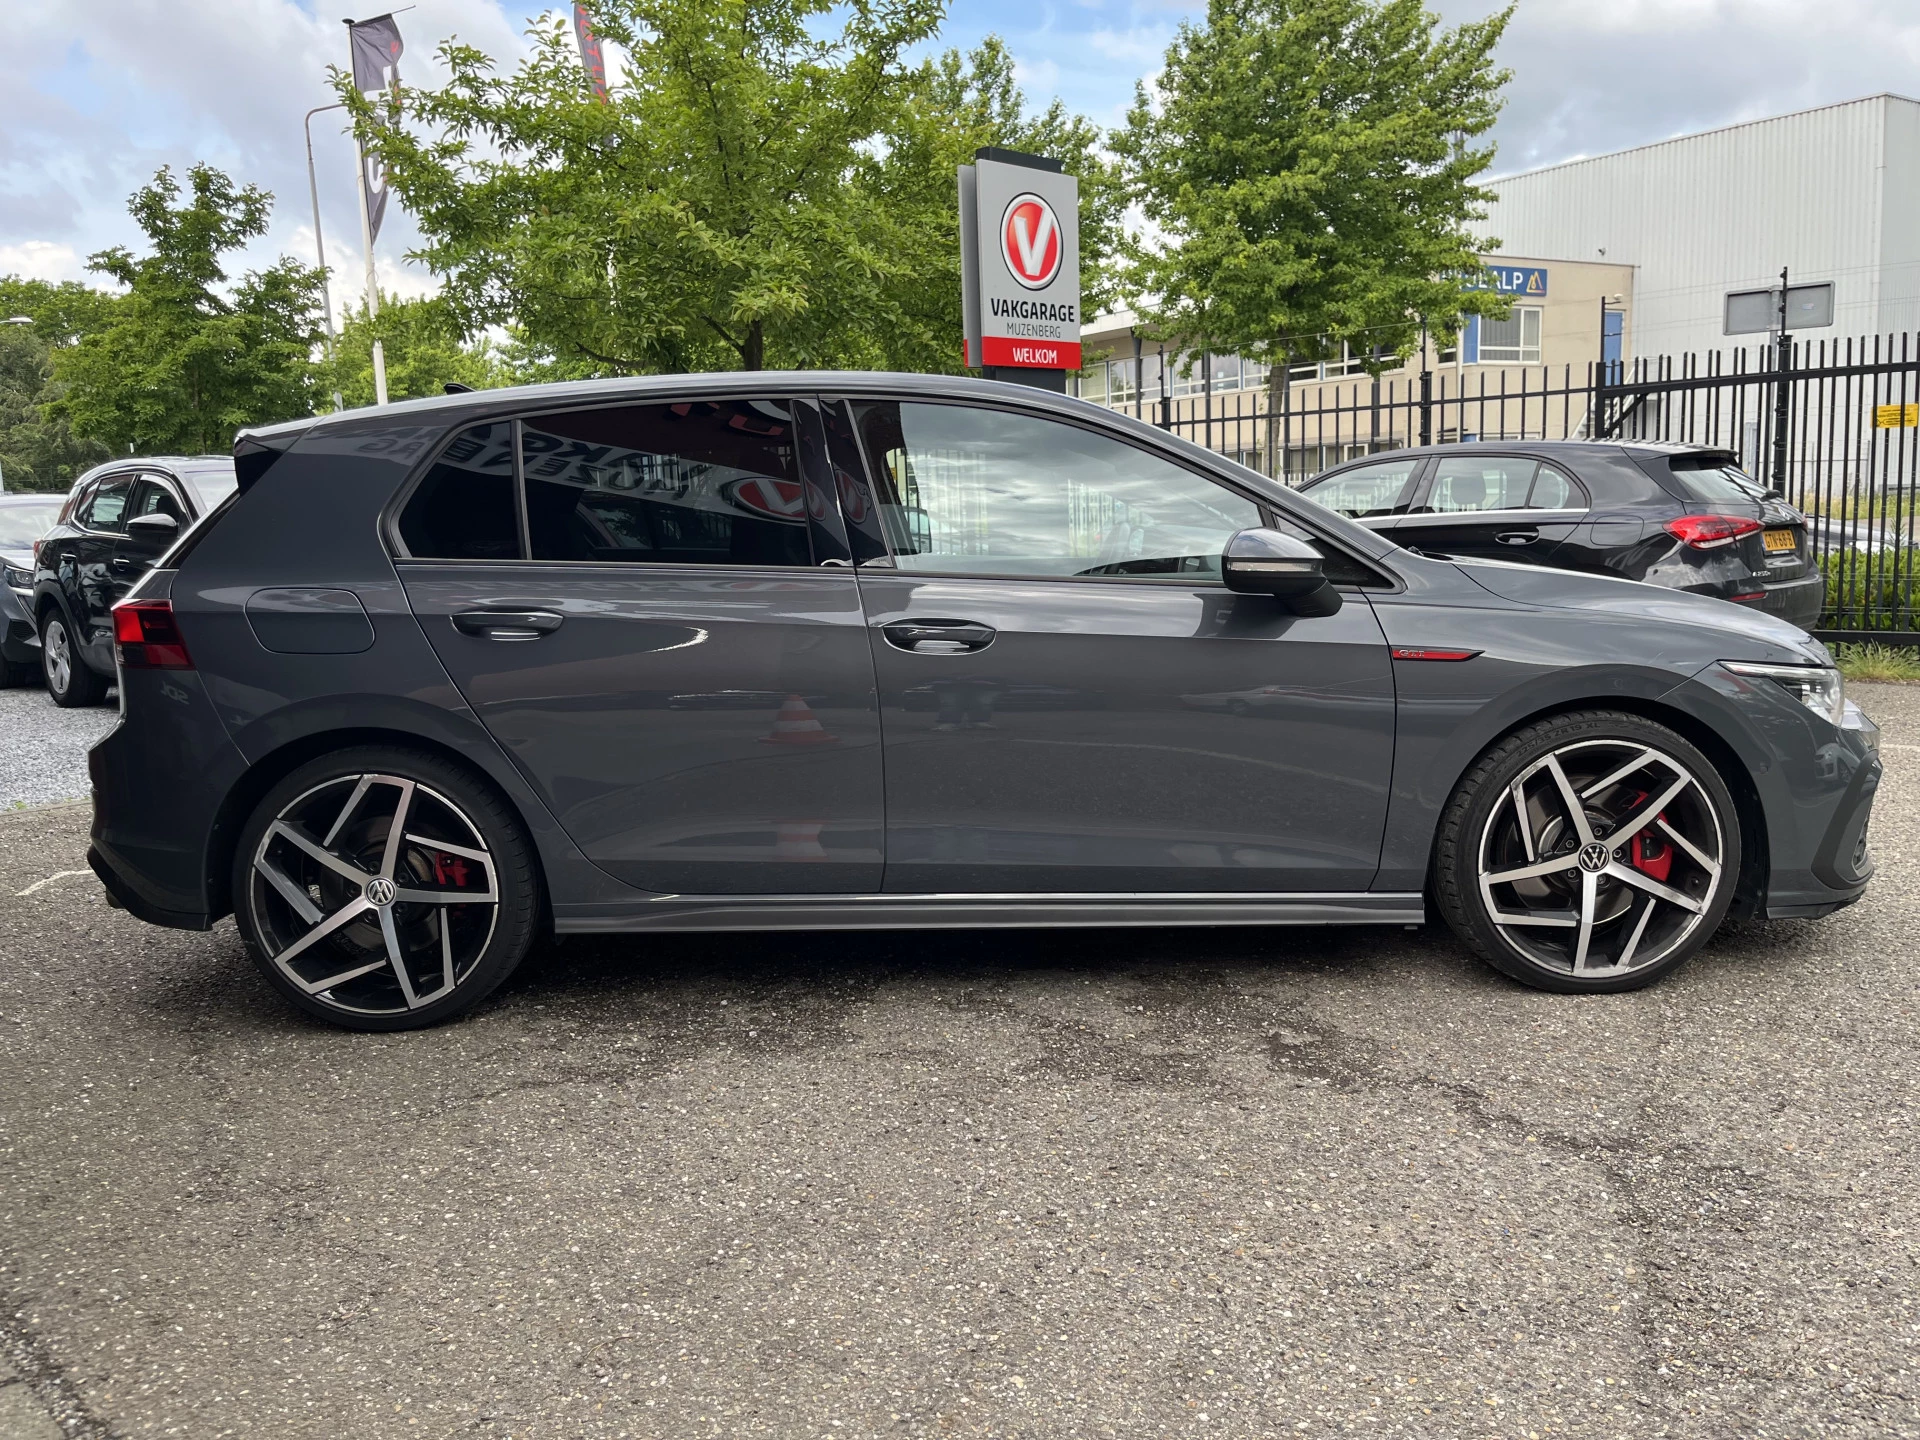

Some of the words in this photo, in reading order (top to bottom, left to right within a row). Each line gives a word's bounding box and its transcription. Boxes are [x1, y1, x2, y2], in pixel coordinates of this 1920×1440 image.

[990, 298, 1075, 322] VAKGARAGE
[1006, 322, 1061, 339] MUZENBERG
[1012, 347, 1057, 365] WELKOM
[1399, 649, 1425, 657] GTI
